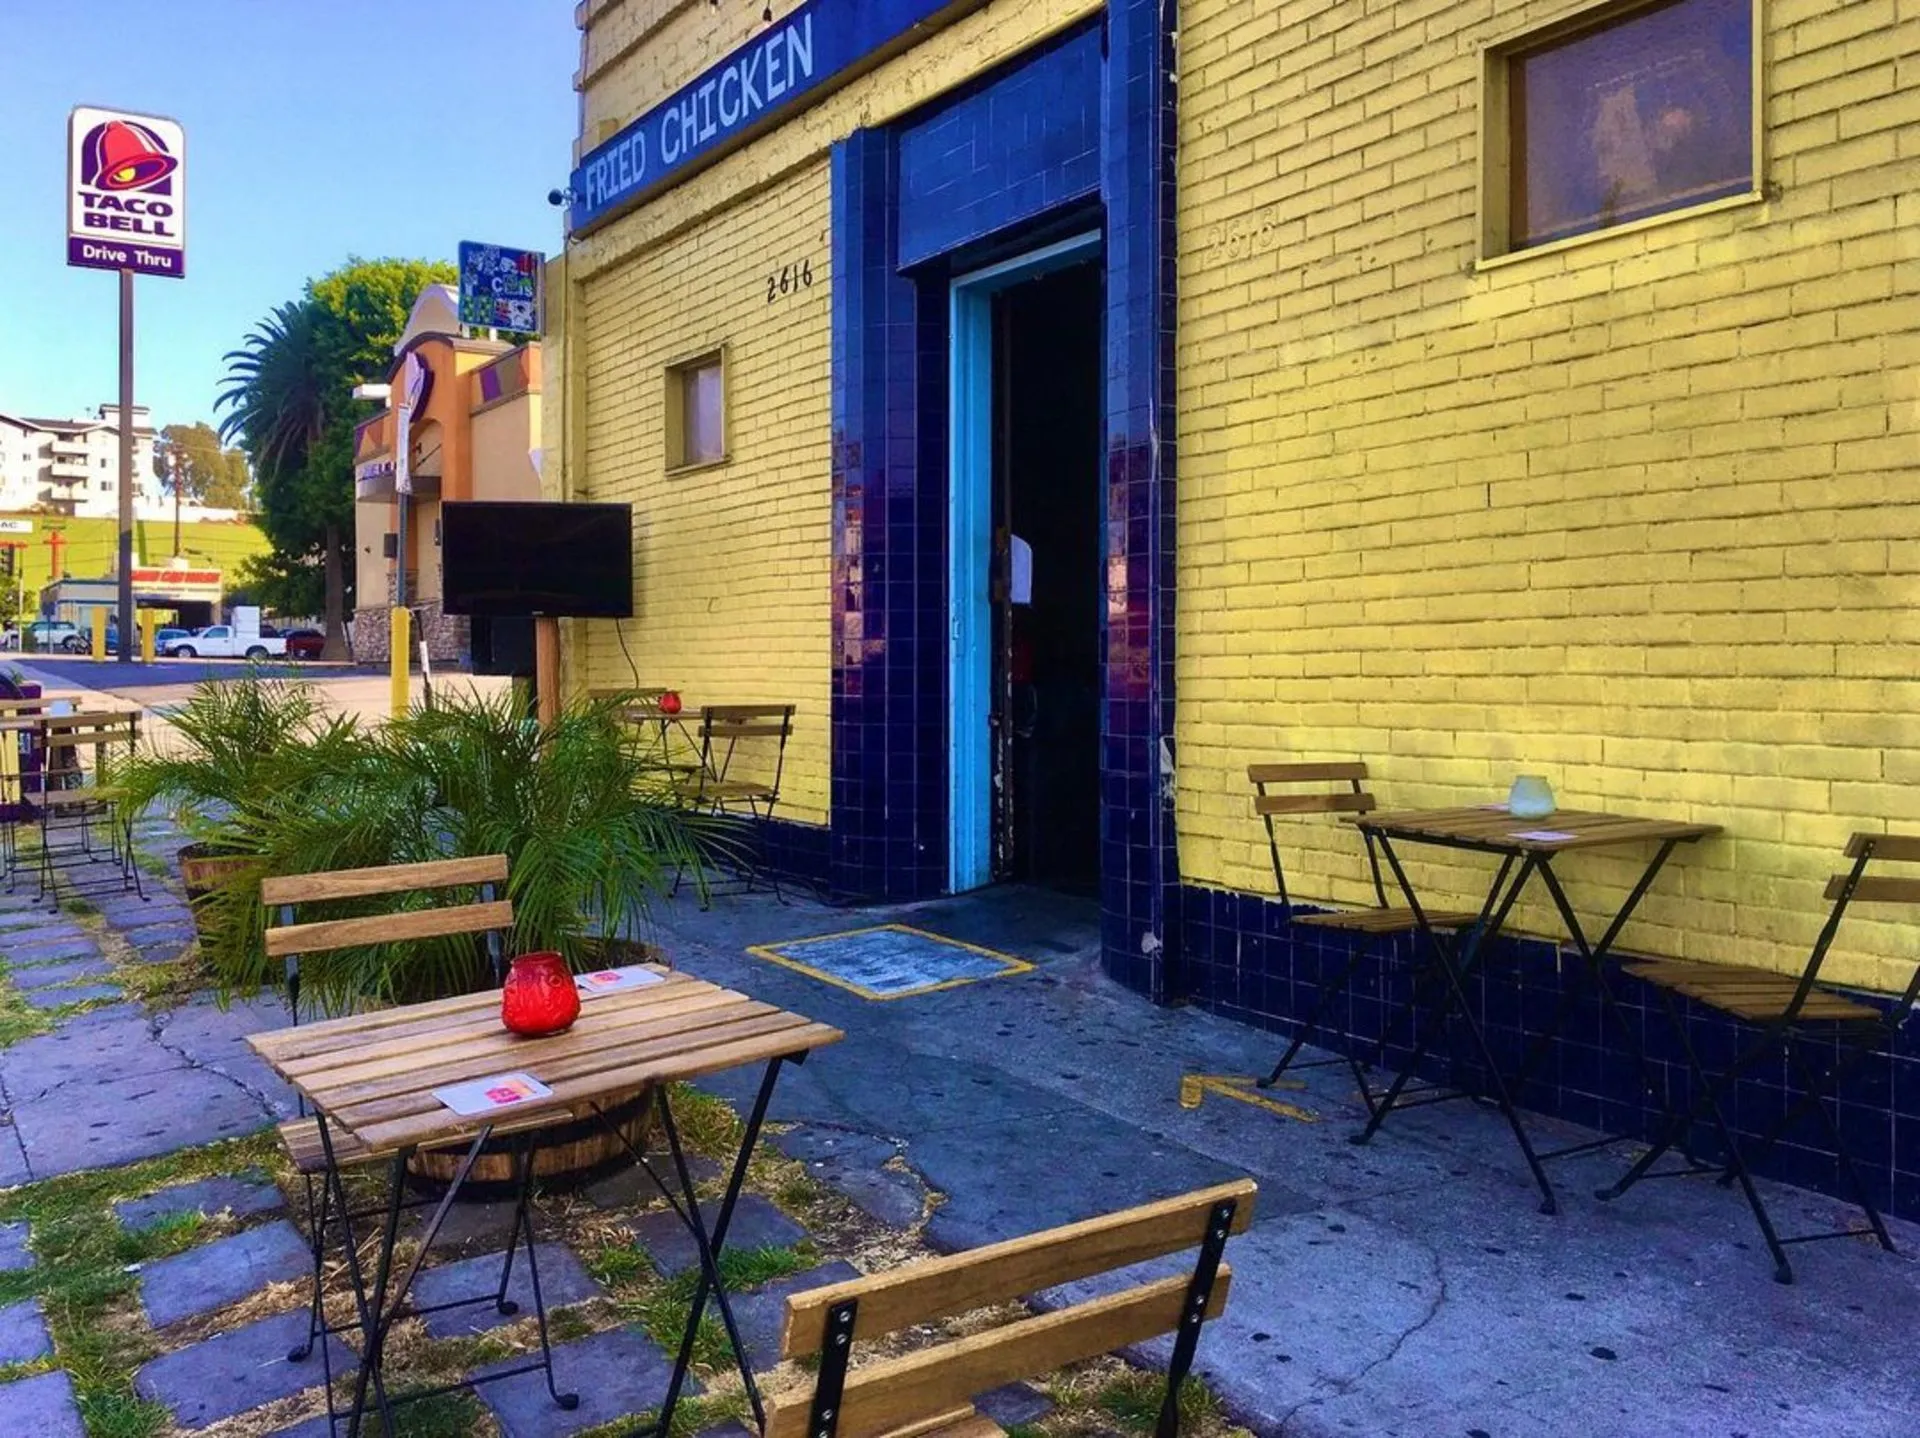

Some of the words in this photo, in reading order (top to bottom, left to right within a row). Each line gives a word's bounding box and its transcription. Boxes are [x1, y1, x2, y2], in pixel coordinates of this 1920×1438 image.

[585, 130, 646, 211] FRIED
[660, 13, 813, 164] CHICKEN
[78, 191, 173, 217] TACO
[83, 212, 175, 237] BELL
[82, 244, 127, 262] Drive
[133, 250, 172, 268] Thru
[767, 259, 813, 304] 2616
